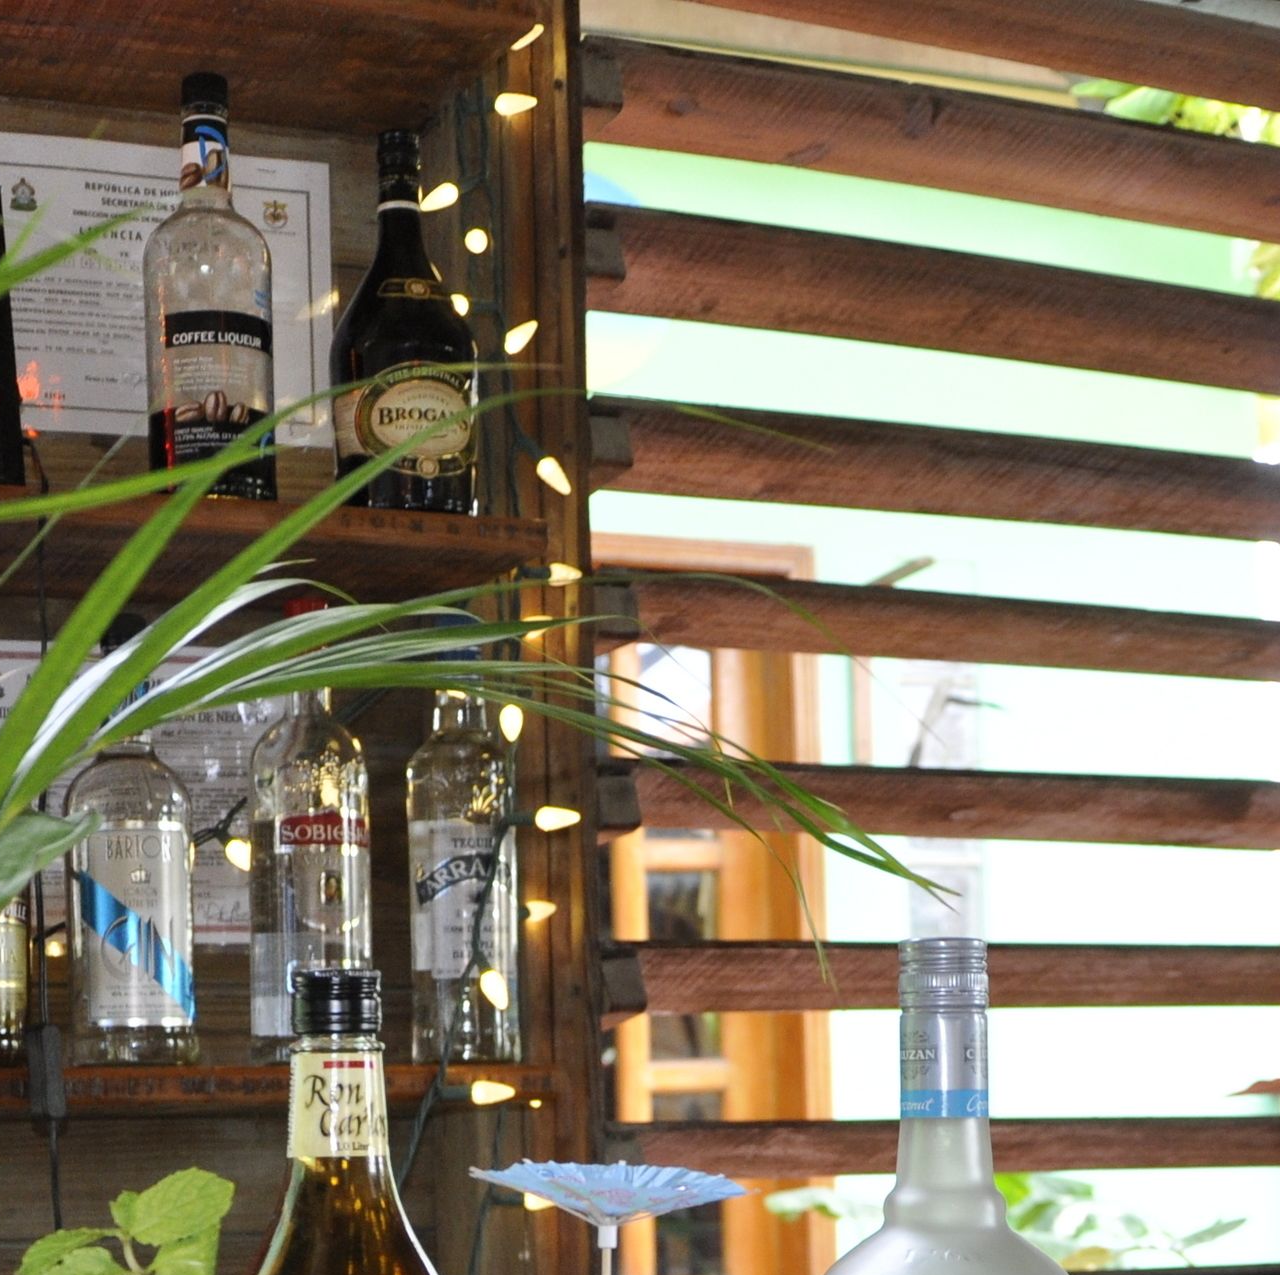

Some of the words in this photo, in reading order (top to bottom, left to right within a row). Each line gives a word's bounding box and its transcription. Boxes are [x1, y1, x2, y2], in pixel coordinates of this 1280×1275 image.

[172, 331, 215, 345] COFFEE
[218, 332, 262, 349] LIQUEUR
[106, 835, 174, 864] BARTON
